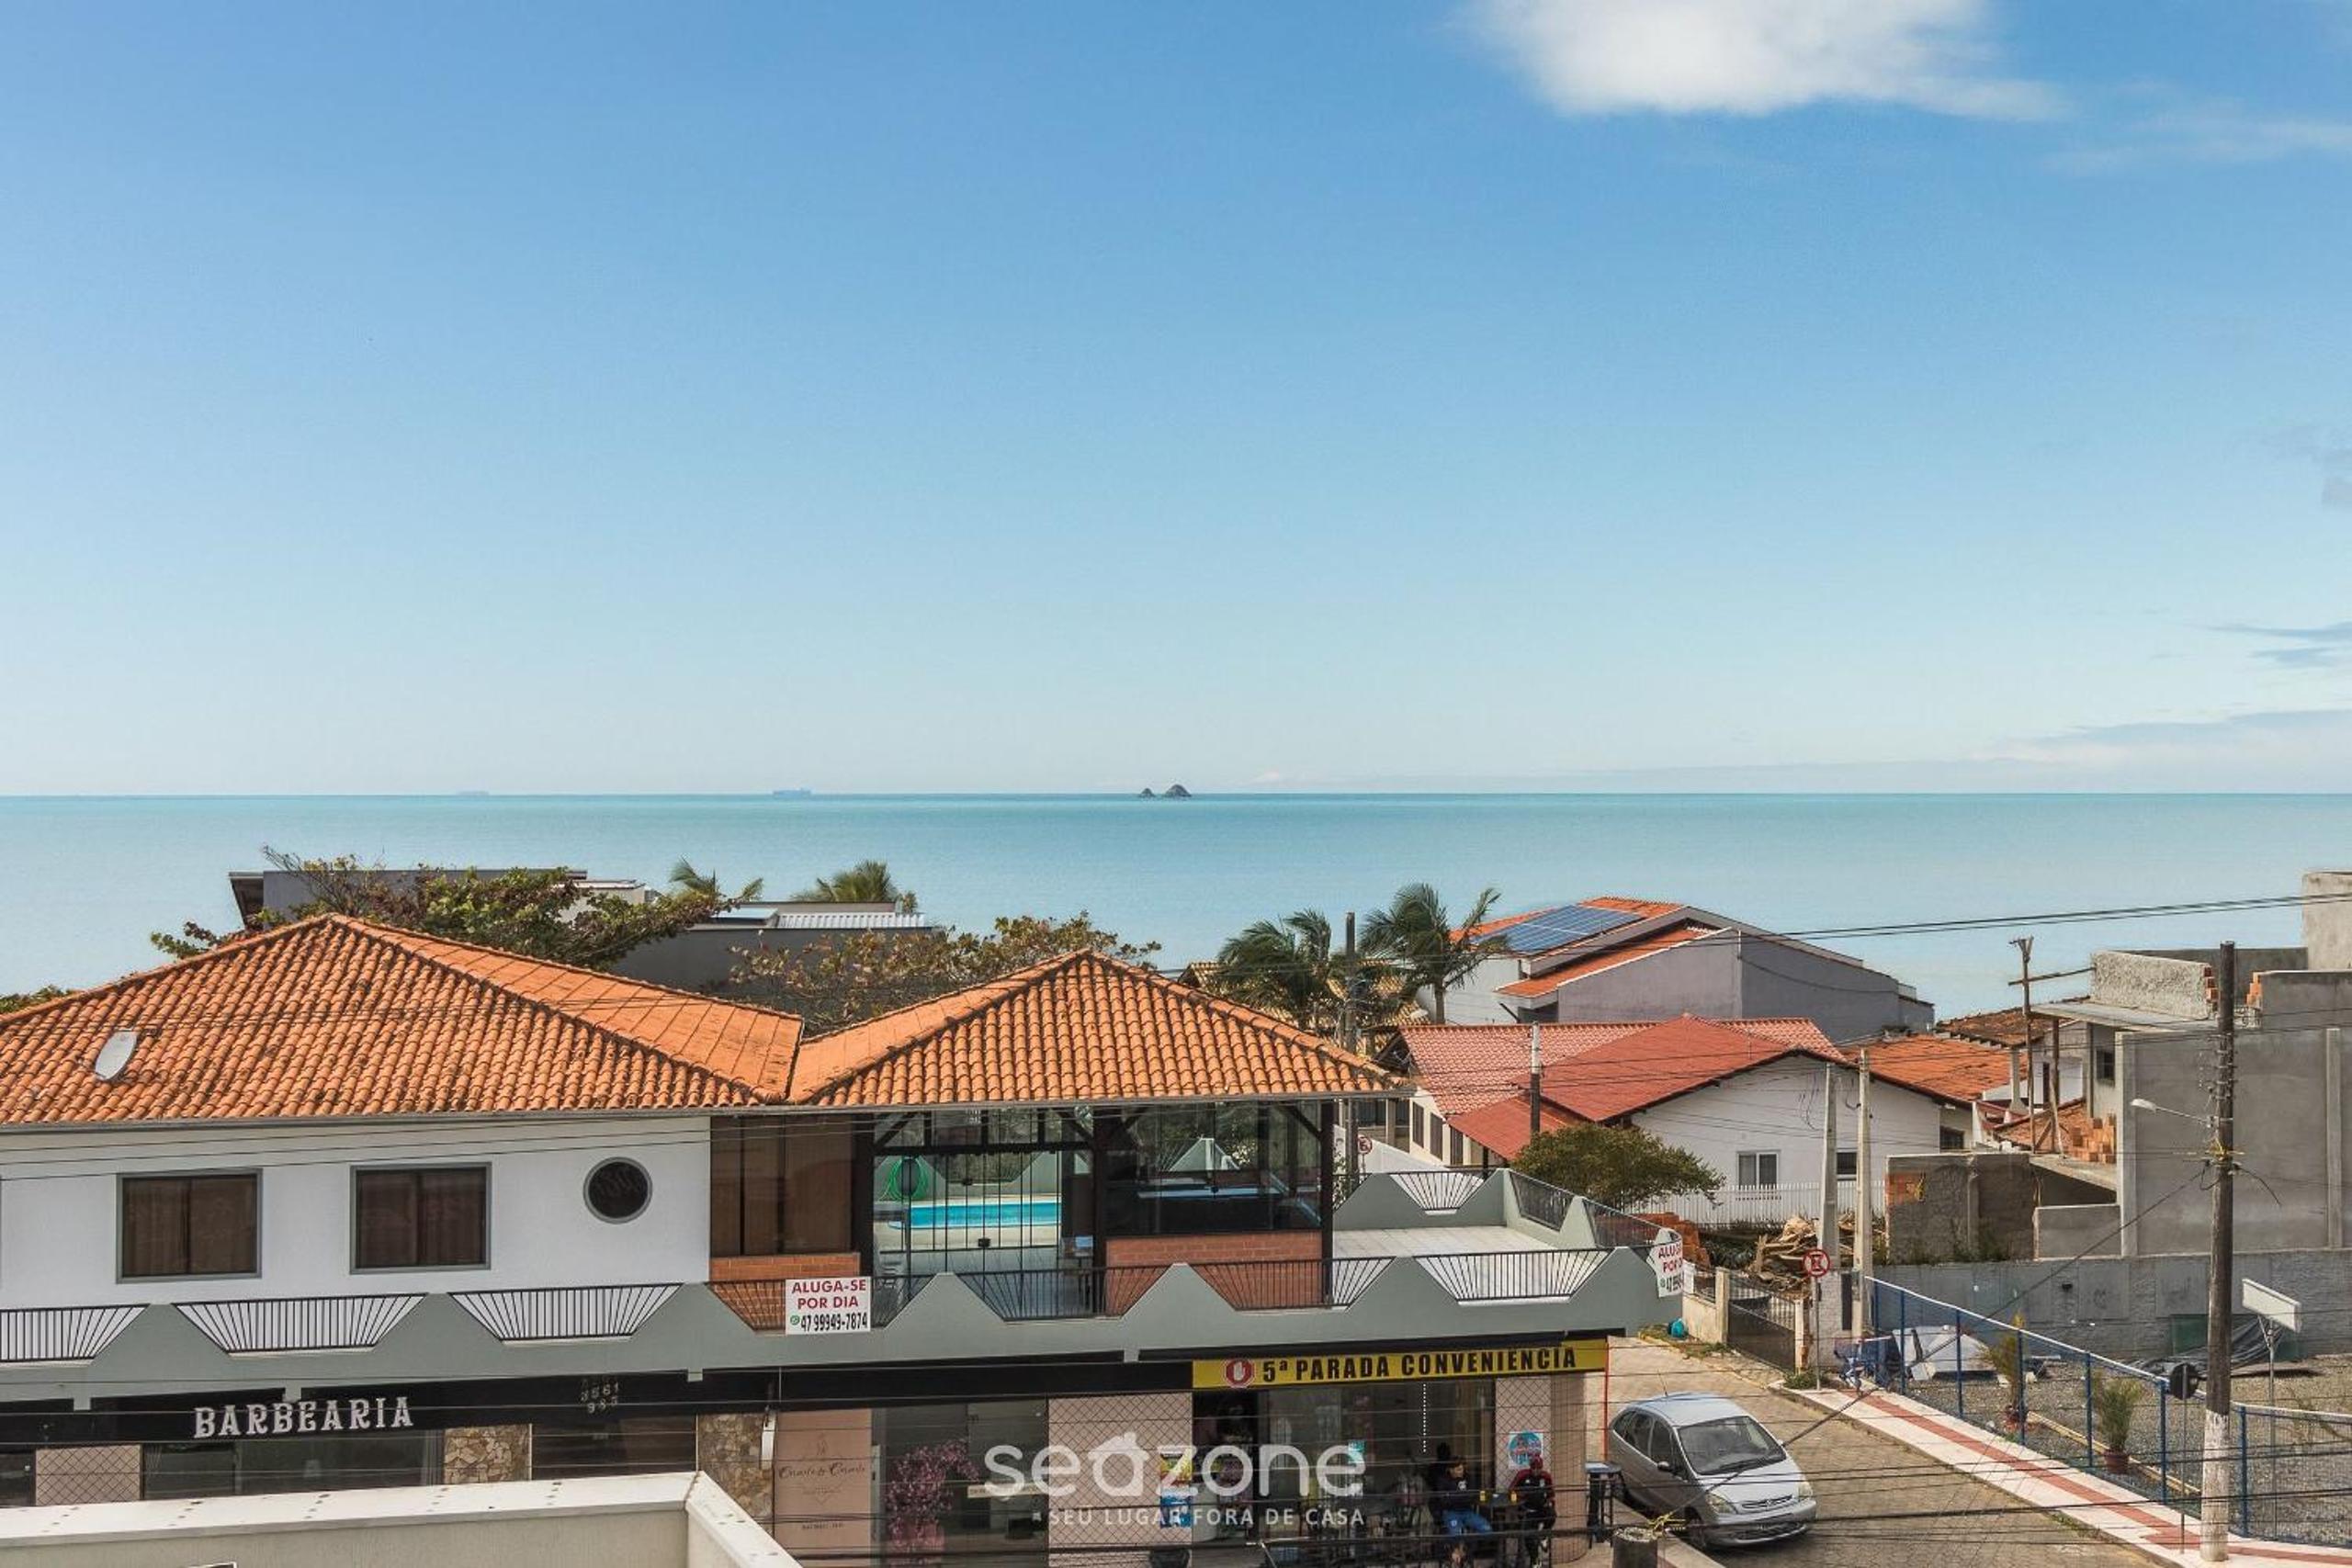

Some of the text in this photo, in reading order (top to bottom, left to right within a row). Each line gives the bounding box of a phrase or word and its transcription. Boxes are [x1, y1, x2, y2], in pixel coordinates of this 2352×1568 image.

[792, 1280, 865, 1293] ALUGA-SE
[797, 1296, 858, 1309] POR DIA
[801, 1313, 867, 1332] 47 99949-7874
[1296, 1357, 1390, 1381] PARADA
[194, 1396, 413, 1438] BARBEARIA
